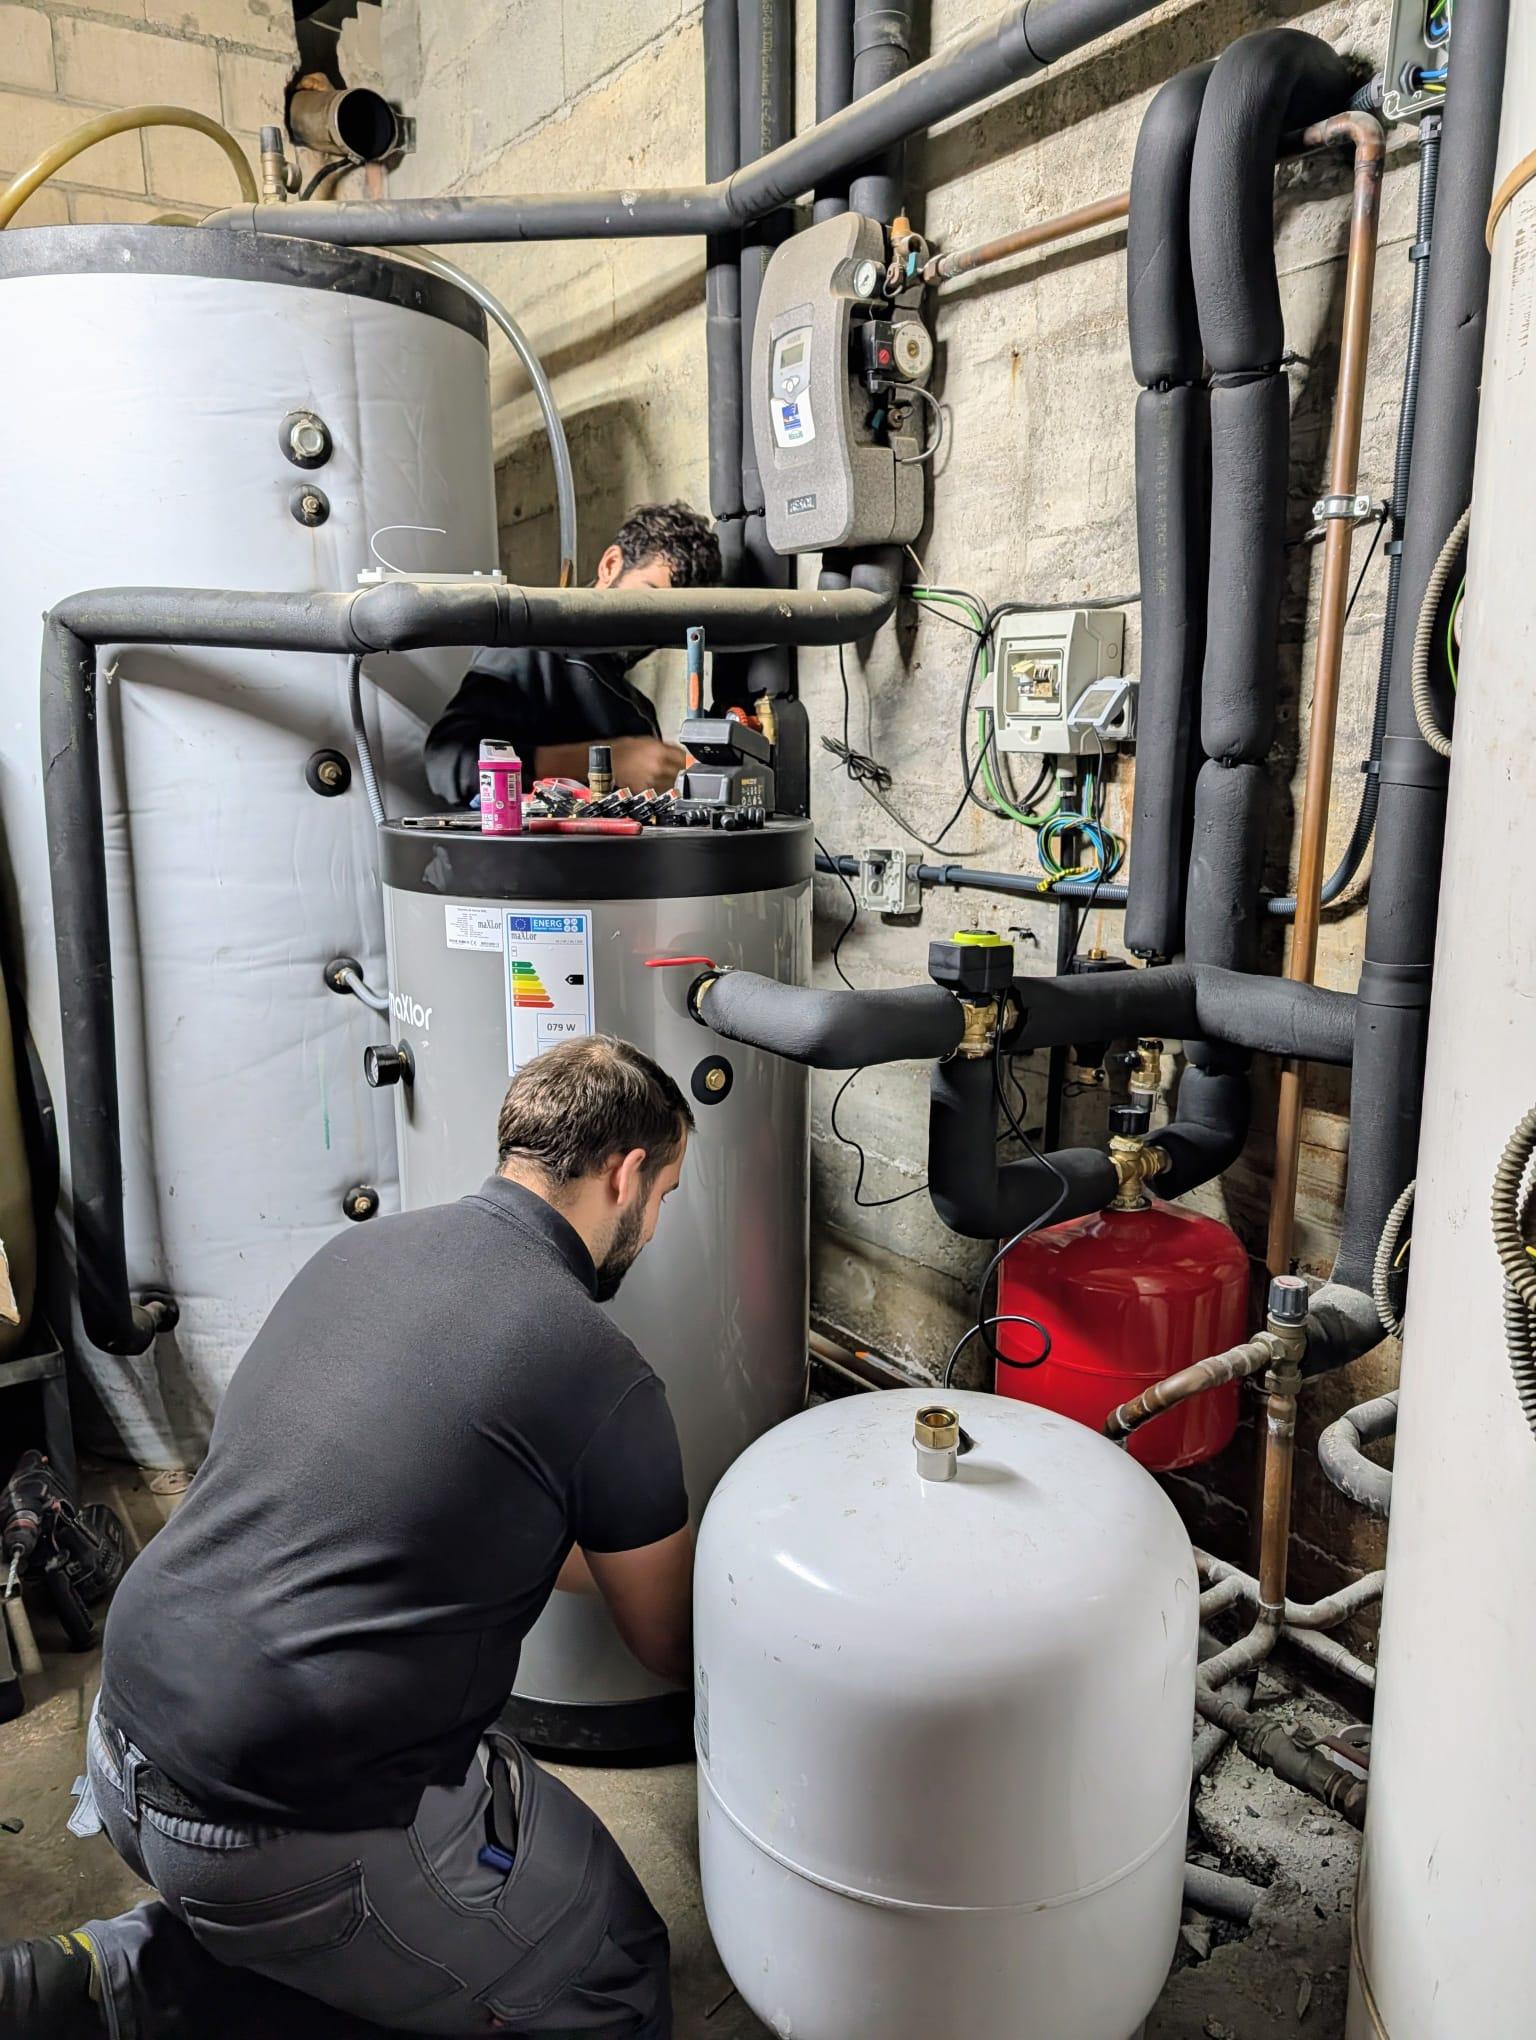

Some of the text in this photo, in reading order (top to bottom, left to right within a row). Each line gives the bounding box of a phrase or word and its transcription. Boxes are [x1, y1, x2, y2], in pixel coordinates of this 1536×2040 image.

[533, 919, 563, 928] ENERG
[546, 1023, 577, 1032] 079 W
